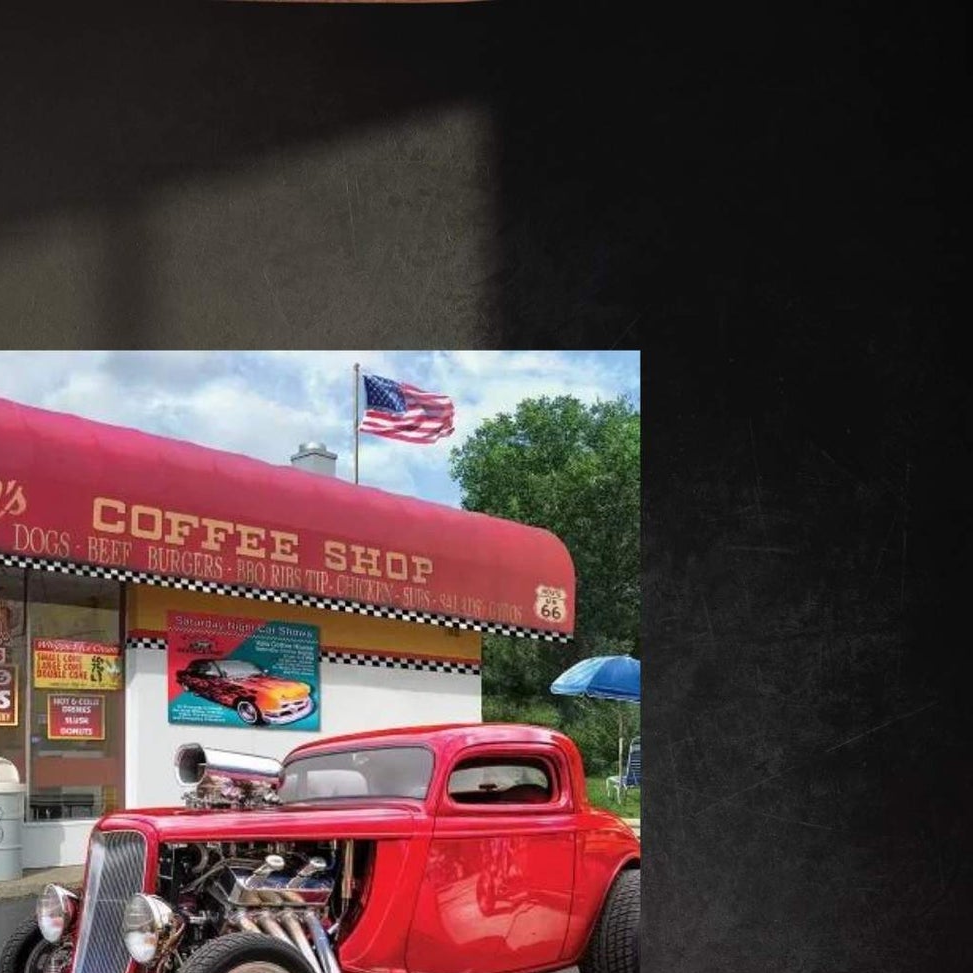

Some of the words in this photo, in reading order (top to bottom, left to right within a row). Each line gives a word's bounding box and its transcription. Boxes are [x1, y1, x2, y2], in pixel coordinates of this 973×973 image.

[92, 496, 299, 564] COFFEE
[324, 540, 434, 584] SHOP
[12, 523, 71, 559] DOGS
[88, 536, 132, 568] BEEF
[147, 546, 223, 580] BURGERS
[271, 563, 302, 589] RIBS
[541, 604, 562, 620] 66
[176, 616, 223, 631] Saturday
[228, 621, 254, 633] Night
[258, 623, 276, 634] Car
[53, 697, 69, 706] HOT
[59, 728, 94, 736] DONUTS
